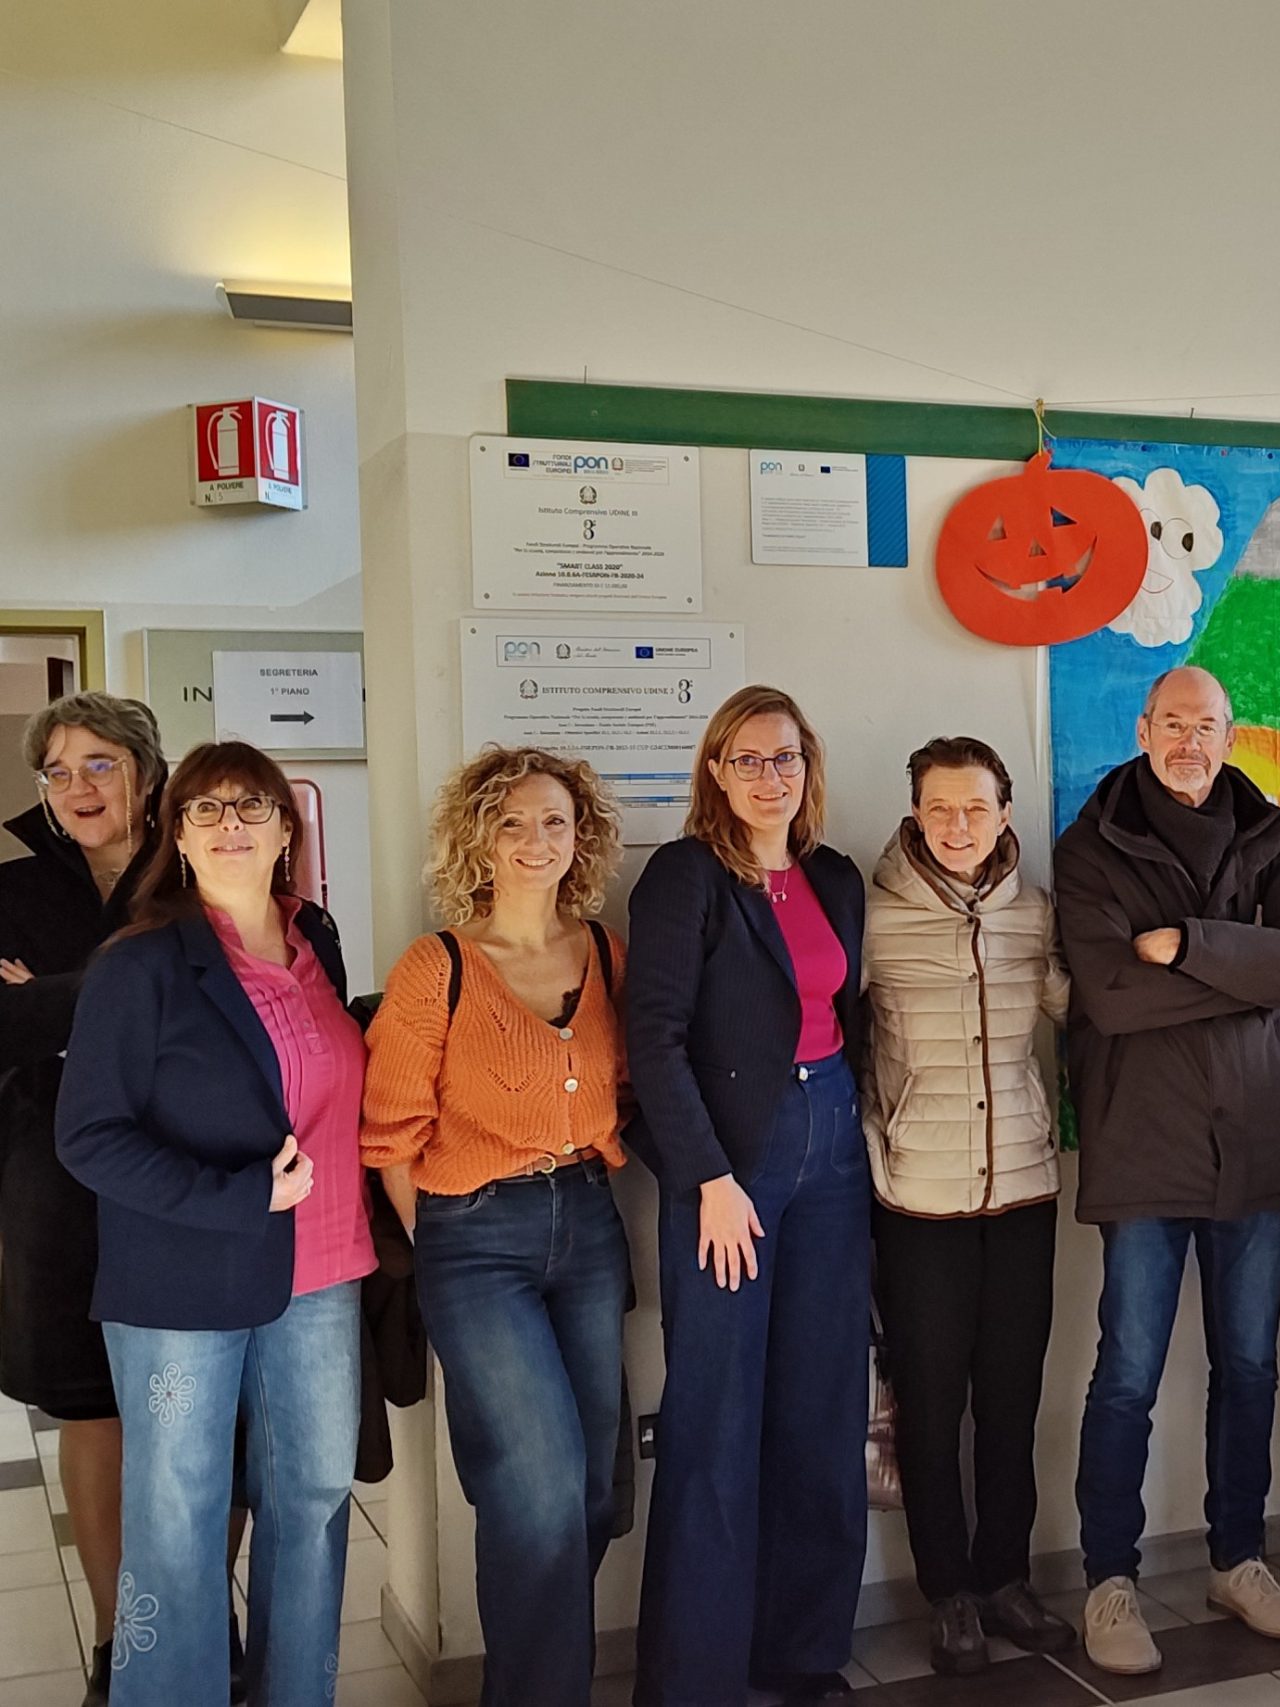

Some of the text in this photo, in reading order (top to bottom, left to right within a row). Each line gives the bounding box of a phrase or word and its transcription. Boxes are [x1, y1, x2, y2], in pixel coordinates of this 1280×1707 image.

[574, 455, 608, 474] pon
[760, 462, 782, 474] pon
[217, 481, 244, 490] POLVERE
[259, 668, 318, 677] SEGRETERIA
[281, 687, 310, 696] PIANO
[582, 687, 643, 695] COMPRENSIVO
[643, 687, 668, 695] UDINE
